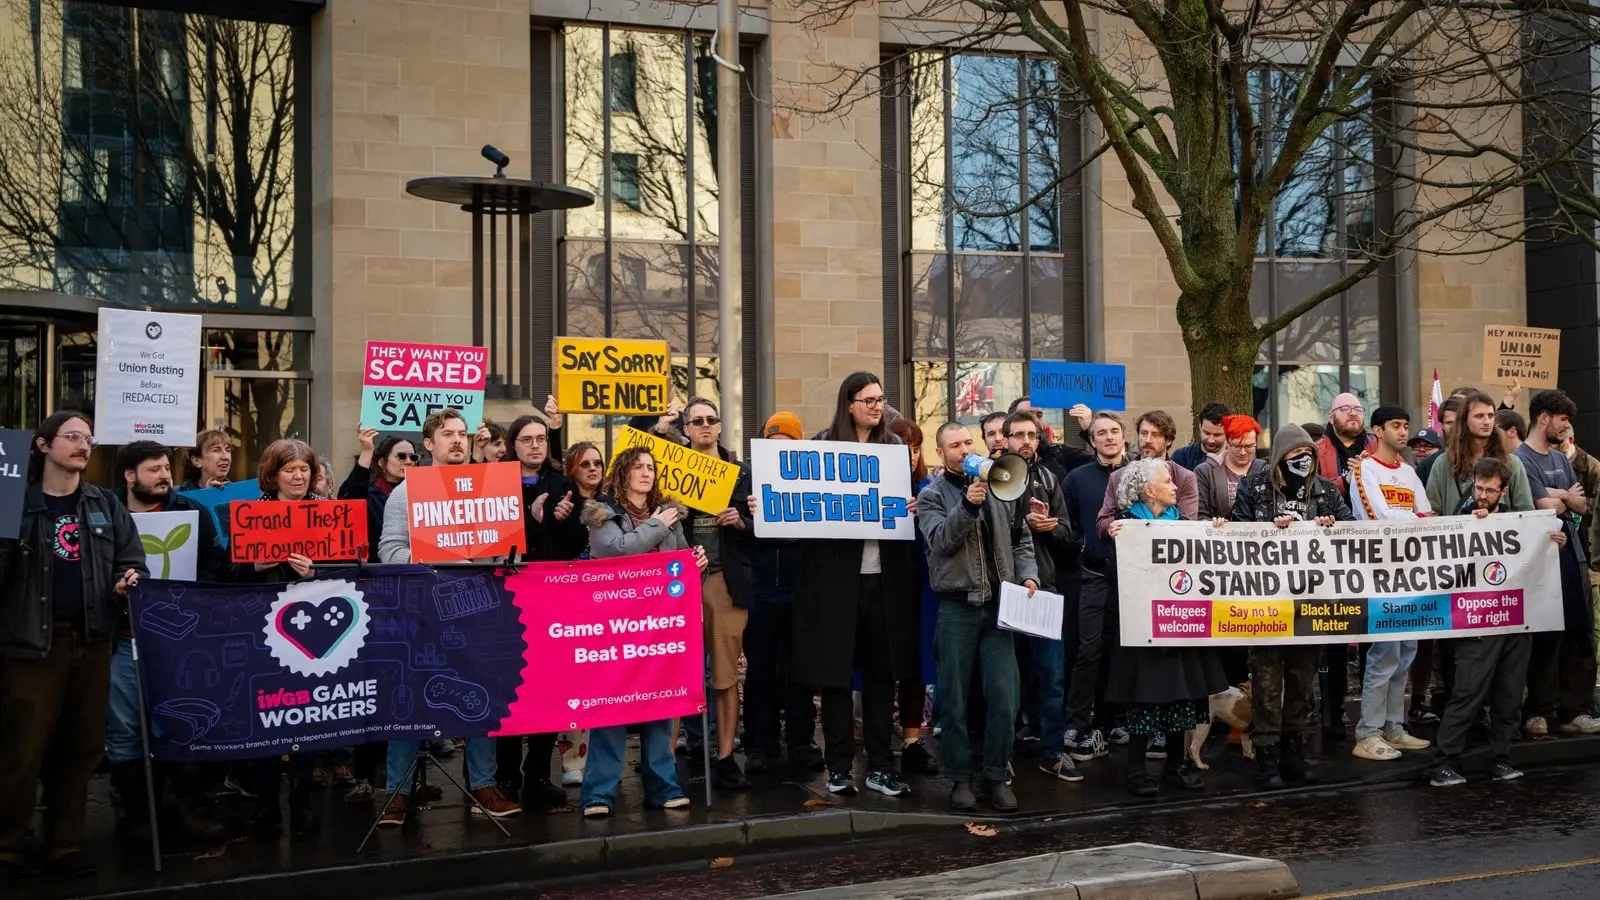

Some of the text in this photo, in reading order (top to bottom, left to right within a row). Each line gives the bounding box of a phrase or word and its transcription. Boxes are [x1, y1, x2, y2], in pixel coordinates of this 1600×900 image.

[1488, 329, 1504, 337] HEY
[370, 346, 484, 362] THEY WANT YOU
[1500, 340, 1542, 354] UNION
[140, 351, 165, 360] We Got
[118, 362, 184, 378] Union Busting
[369, 359, 482, 384] SCARED
[1497, 368, 1550, 380] BOWLING!
[140, 380, 163, 389] Before
[1032, 372, 1125, 394] REINSTATEMENT NOW
[122, 392, 178, 405] [REDACTED]
[374, 391, 474, 405] WE WANT YOU
[582, 380, 664, 412] BE NICE!
[662, 444, 684, 464] NO
[686, 452, 729, 480] OTHER
[454, 478, 474, 492] THE
[236, 503, 355, 530] Grand Theft
[412, 496, 520, 528] PINKERTONS
[436, 529, 500, 548] SALUTE YOU!
[1151, 530, 1521, 566] EDINBURGH & THE LOTHIANS
[544, 566, 662, 584] IWGB Game Workers
[1198, 562, 1476, 596] STAND UP TO RACISM
[592, 586, 664, 602] @IWGB_GW
[1301, 602, 1362, 616] Black Lives
[1382, 601, 1438, 617] Stamp out
[1457, 595, 1518, 611] Oppose the
[1157, 604, 1206, 620] Refugees
[1230, 606, 1278, 618] Say no to
[1467, 610, 1510, 626] far right
[548, 614, 686, 638] Game Workers
[1158, 620, 1205, 633] welcome
[1218, 620, 1288, 635] Islamophobia
[1312, 618, 1349, 632] Matter
[1375, 615, 1444, 629] antisemitism
[574, 640, 686, 664] Beat Bosses
[312, 679, 378, 703] GAME
[582, 686, 688, 709] gameworkers.co.uk
[258, 698, 377, 728] WORKERS
[214, 742, 245, 750] Workers
[246, 740, 270, 750] branch
[272, 738, 280, 746] of
[281, 736, 294, 744] the
[294, 732, 338, 744] Independent
[338, 728, 366, 738] Workers
[413, 722, 436, 730] Britain
